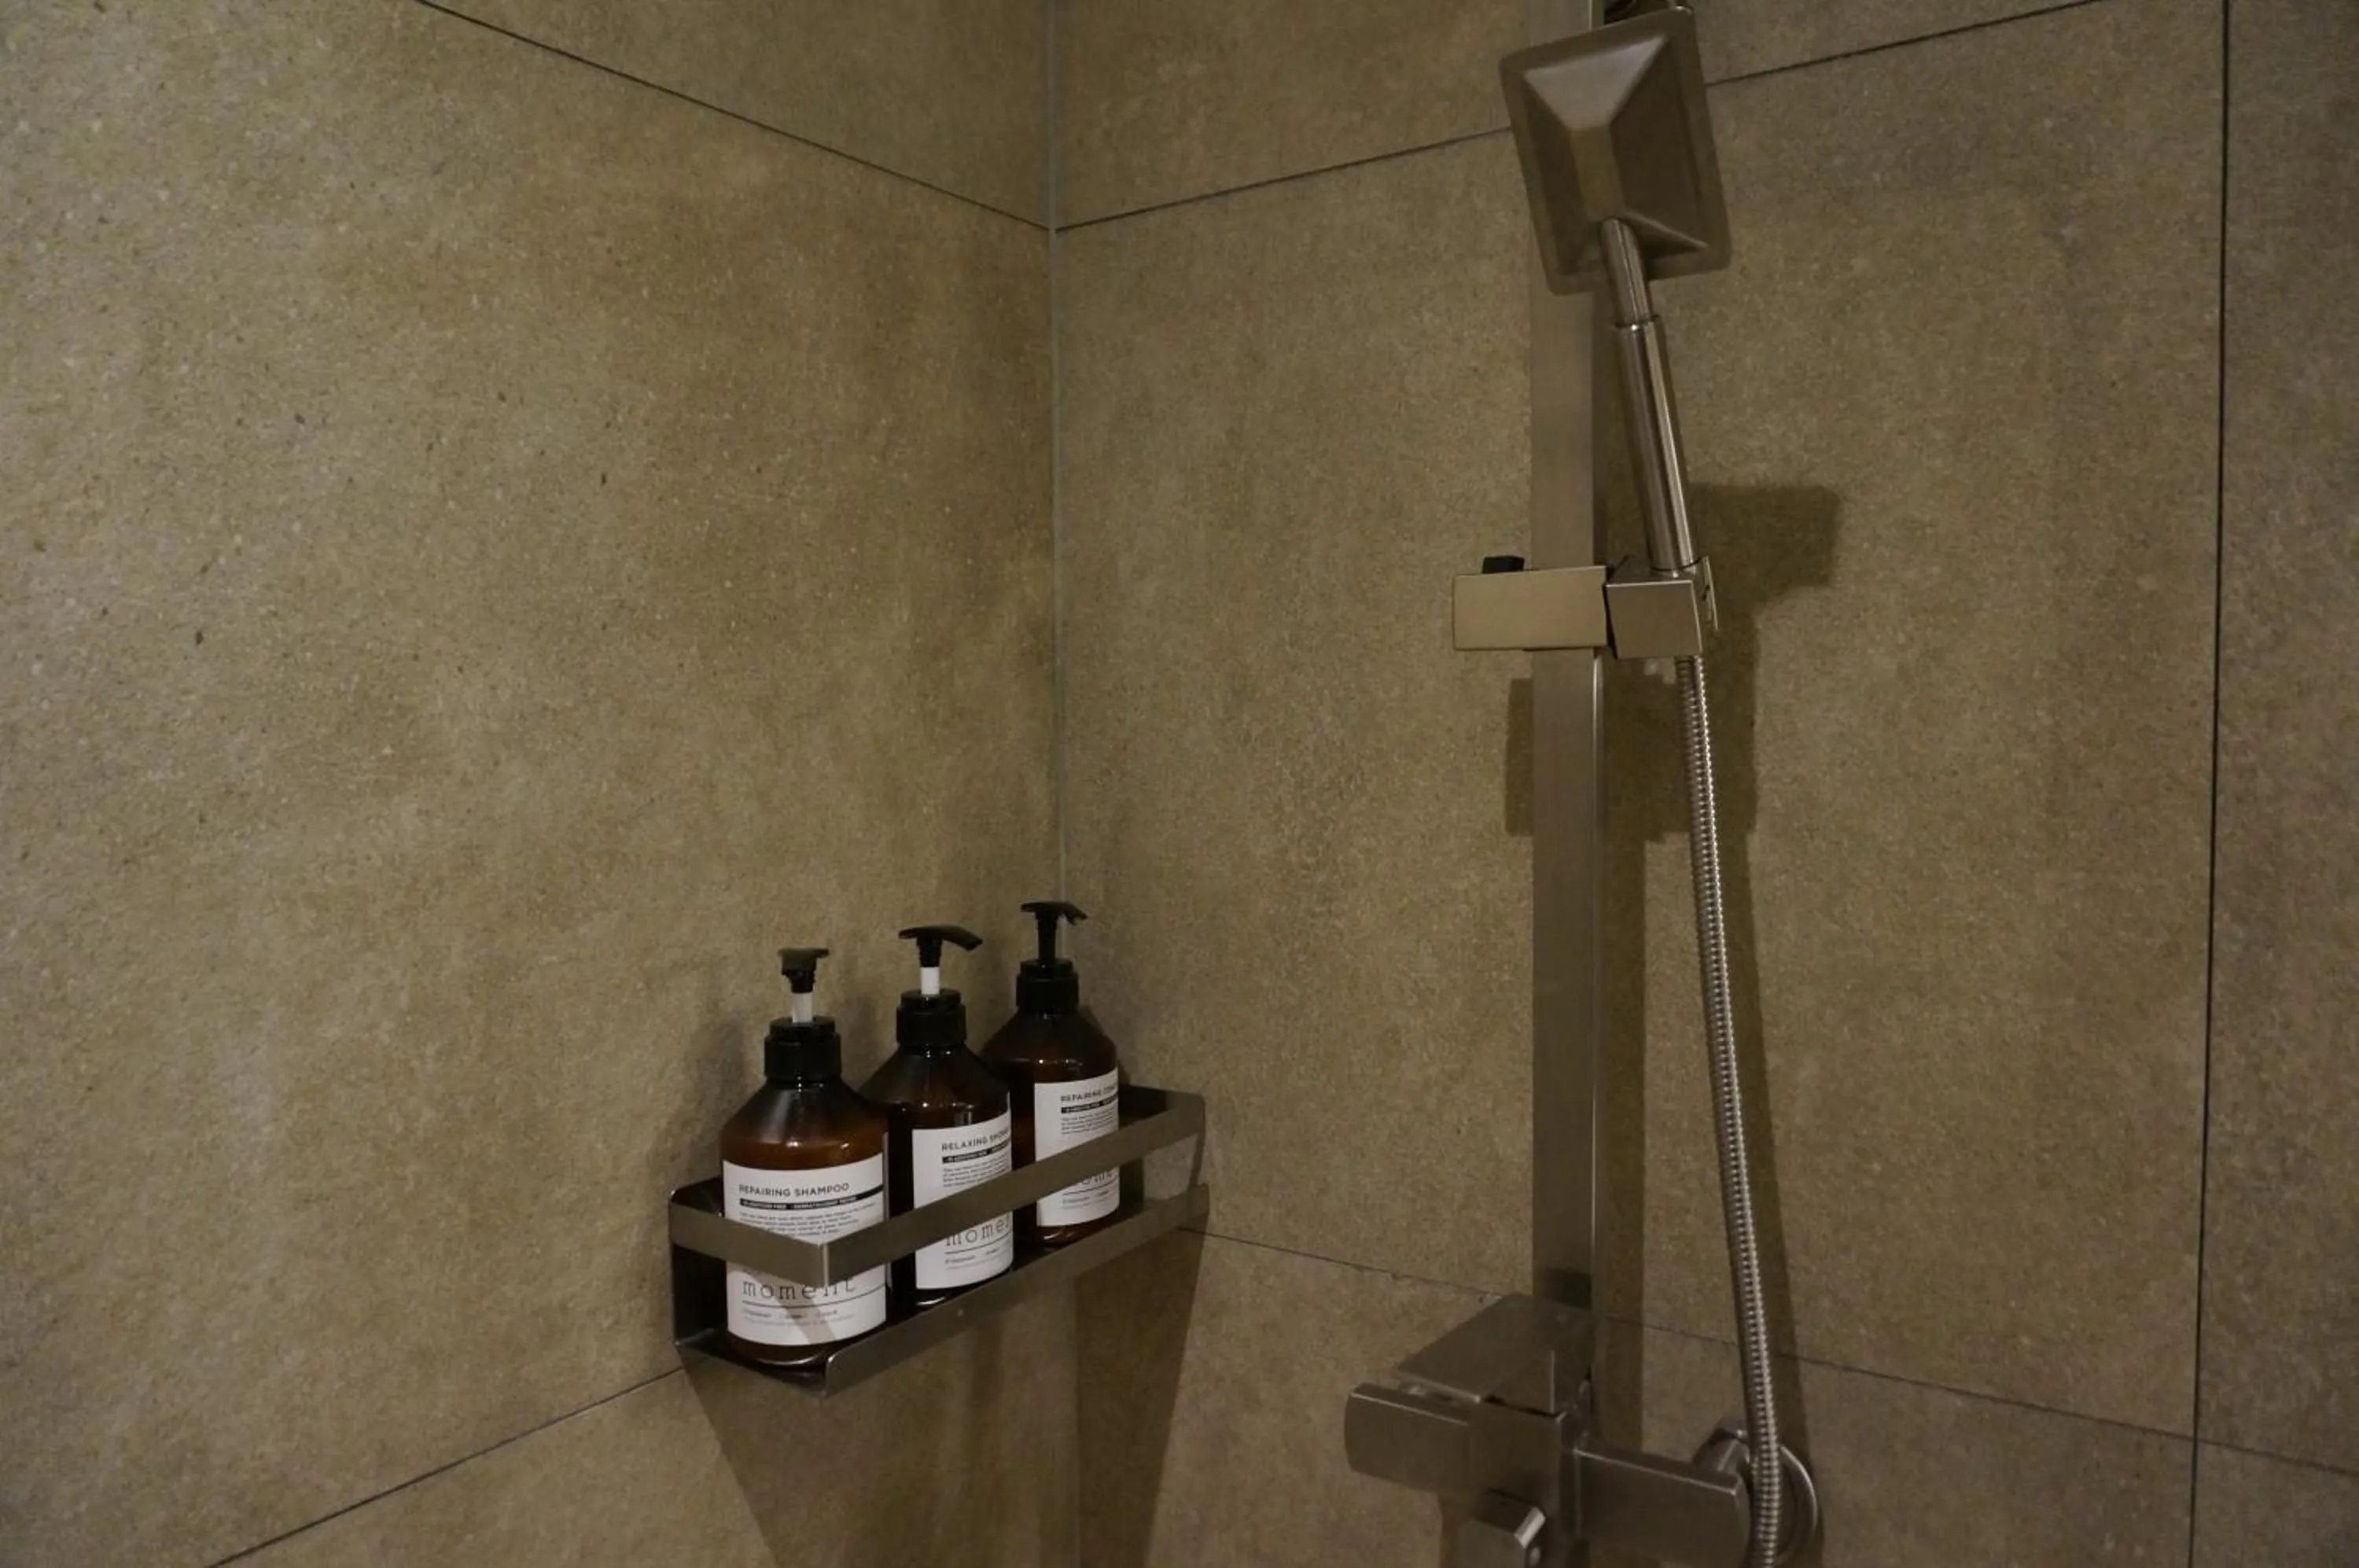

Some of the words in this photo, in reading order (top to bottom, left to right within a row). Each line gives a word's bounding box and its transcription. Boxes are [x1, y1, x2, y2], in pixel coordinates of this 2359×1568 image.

[941, 1136, 988, 1150] RELAXING
[738, 1183, 791, 1197] REPAIRING
[793, 1182, 850, 1197] SHAMPOO
